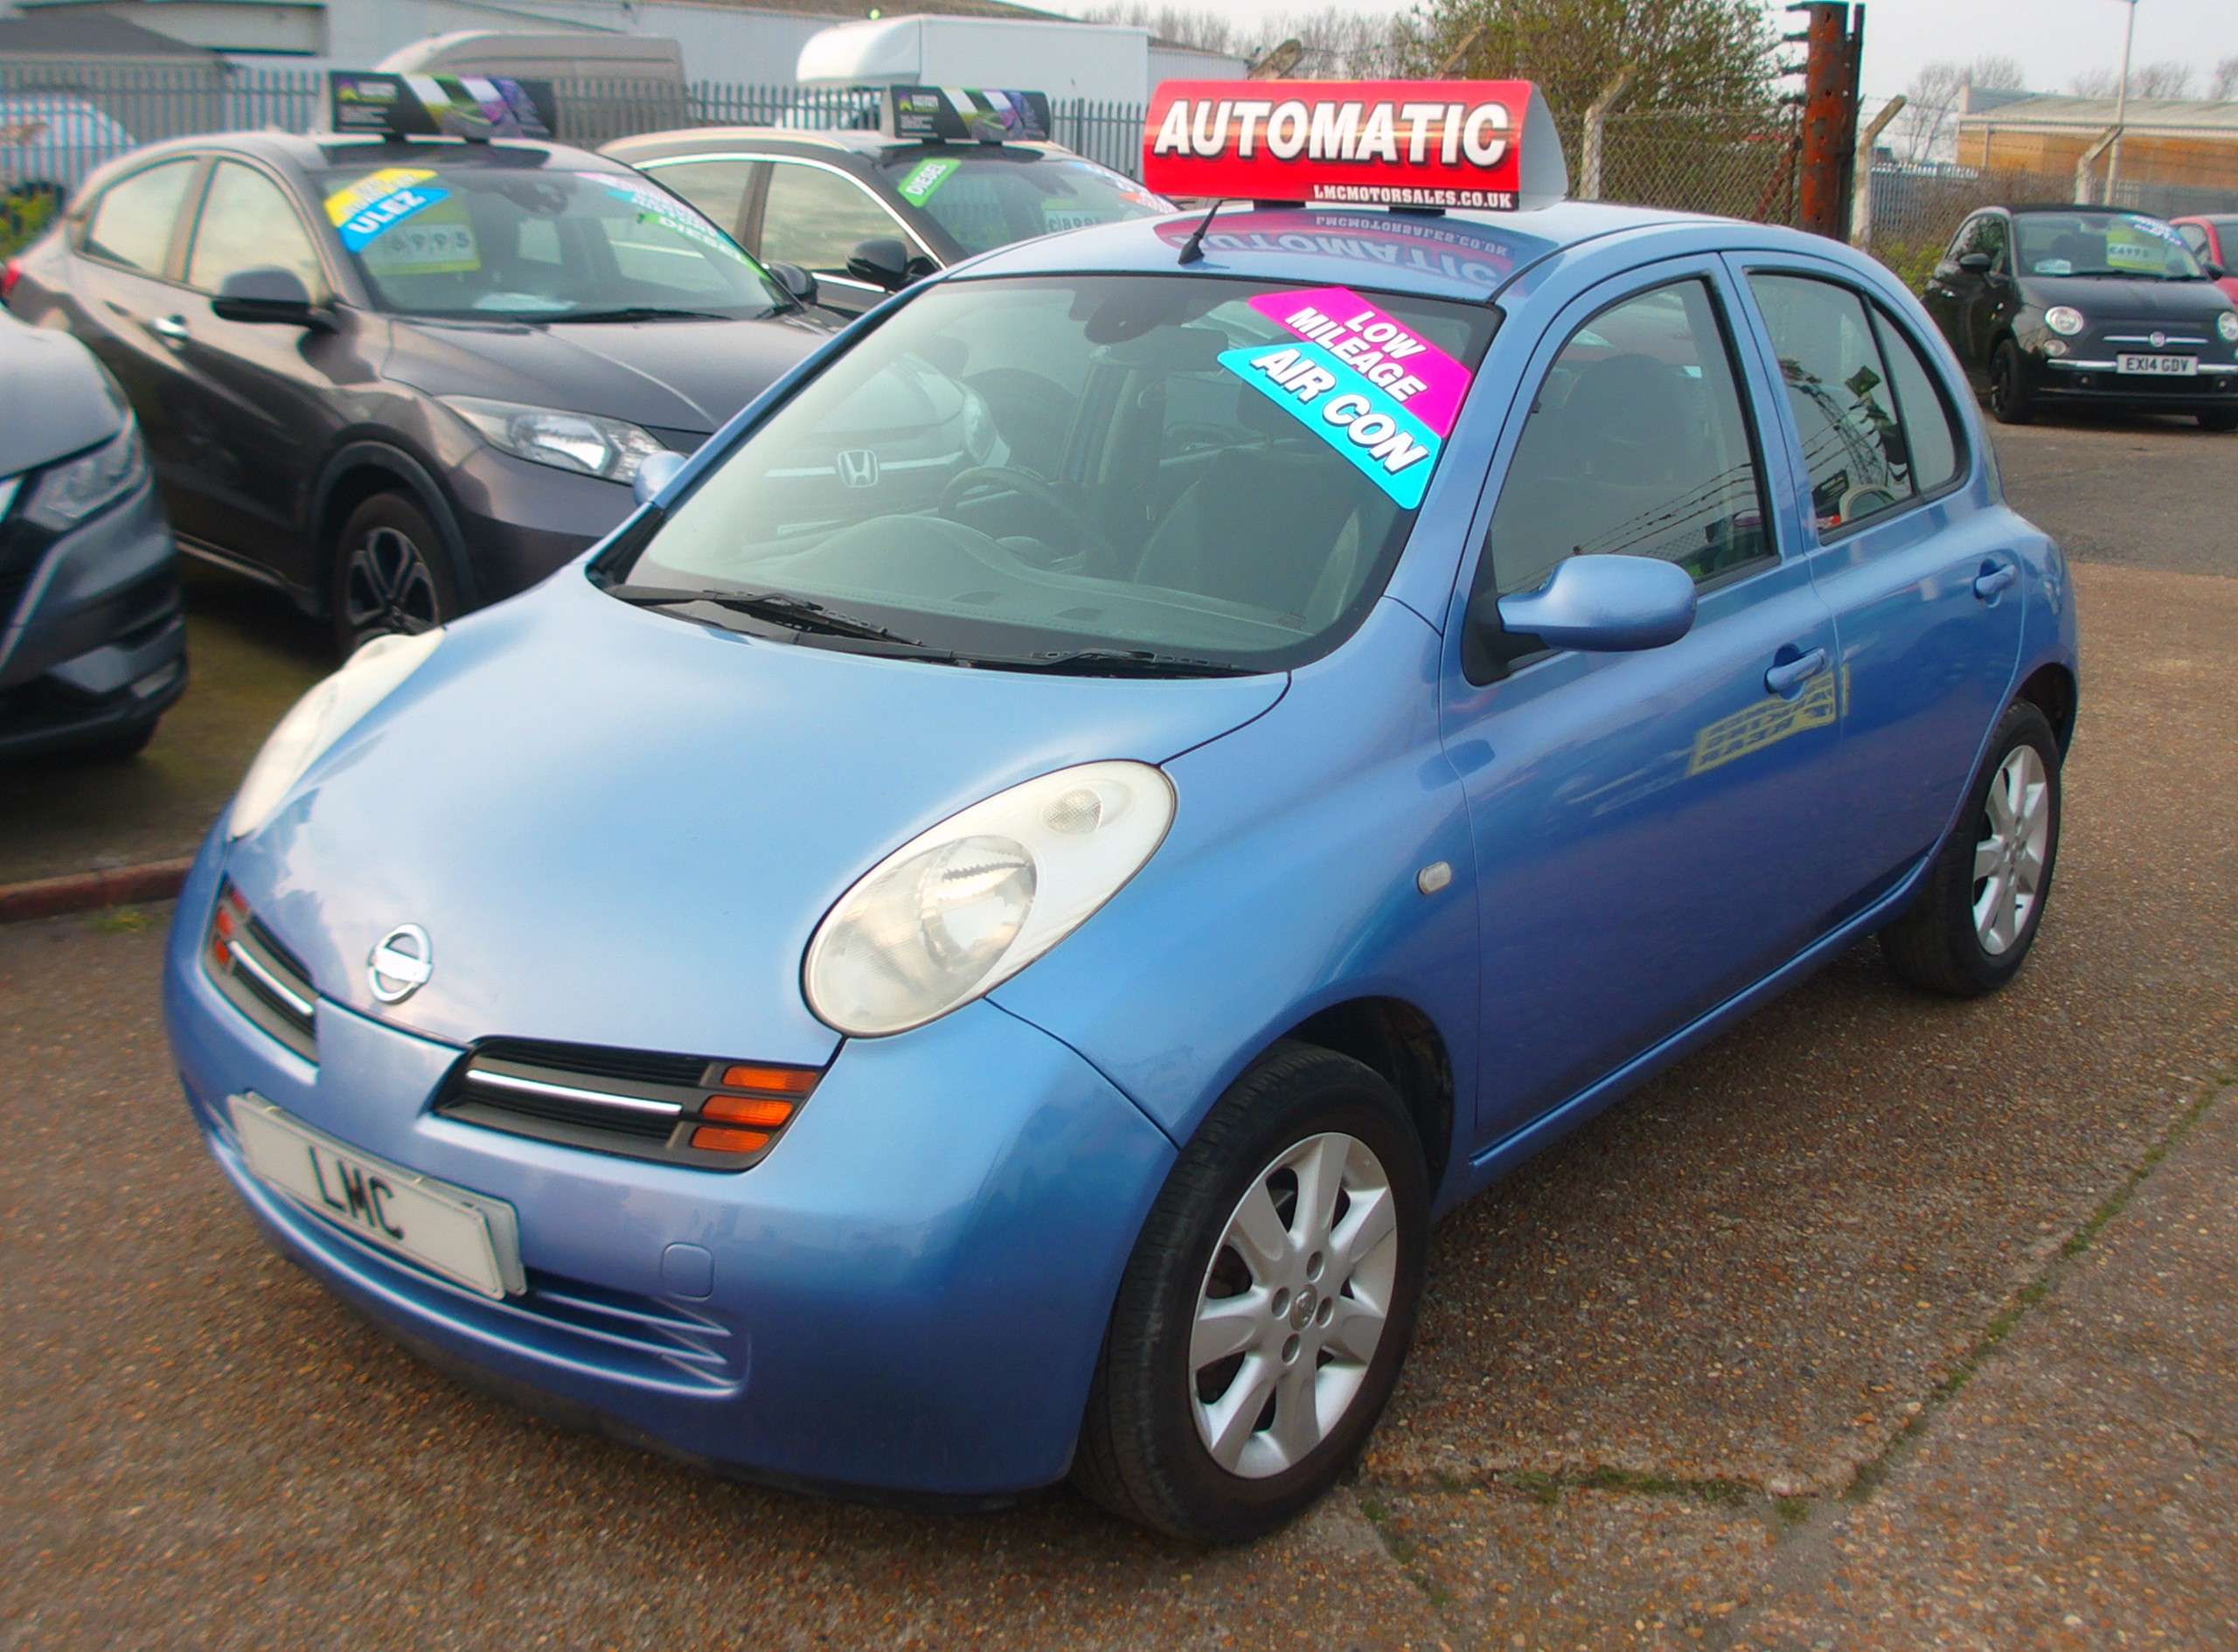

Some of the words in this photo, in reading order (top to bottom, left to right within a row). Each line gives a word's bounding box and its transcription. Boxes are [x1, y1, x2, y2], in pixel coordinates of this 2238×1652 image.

[1152, 99, 1511, 168] AUTOMATIC
[347, 190, 427, 234] ULEZ
[1313, 184, 1512, 209] LMCMOTORSALES.CO.UK
[1284, 307, 1428, 403] MILEAGE
[1344, 310, 1427, 359] LOW
[2125, 357, 2158, 371] EX14
[1248, 348, 1337, 405] AIR
[1322, 393, 1430, 476] CON
[308, 1145, 405, 1241] LMC
